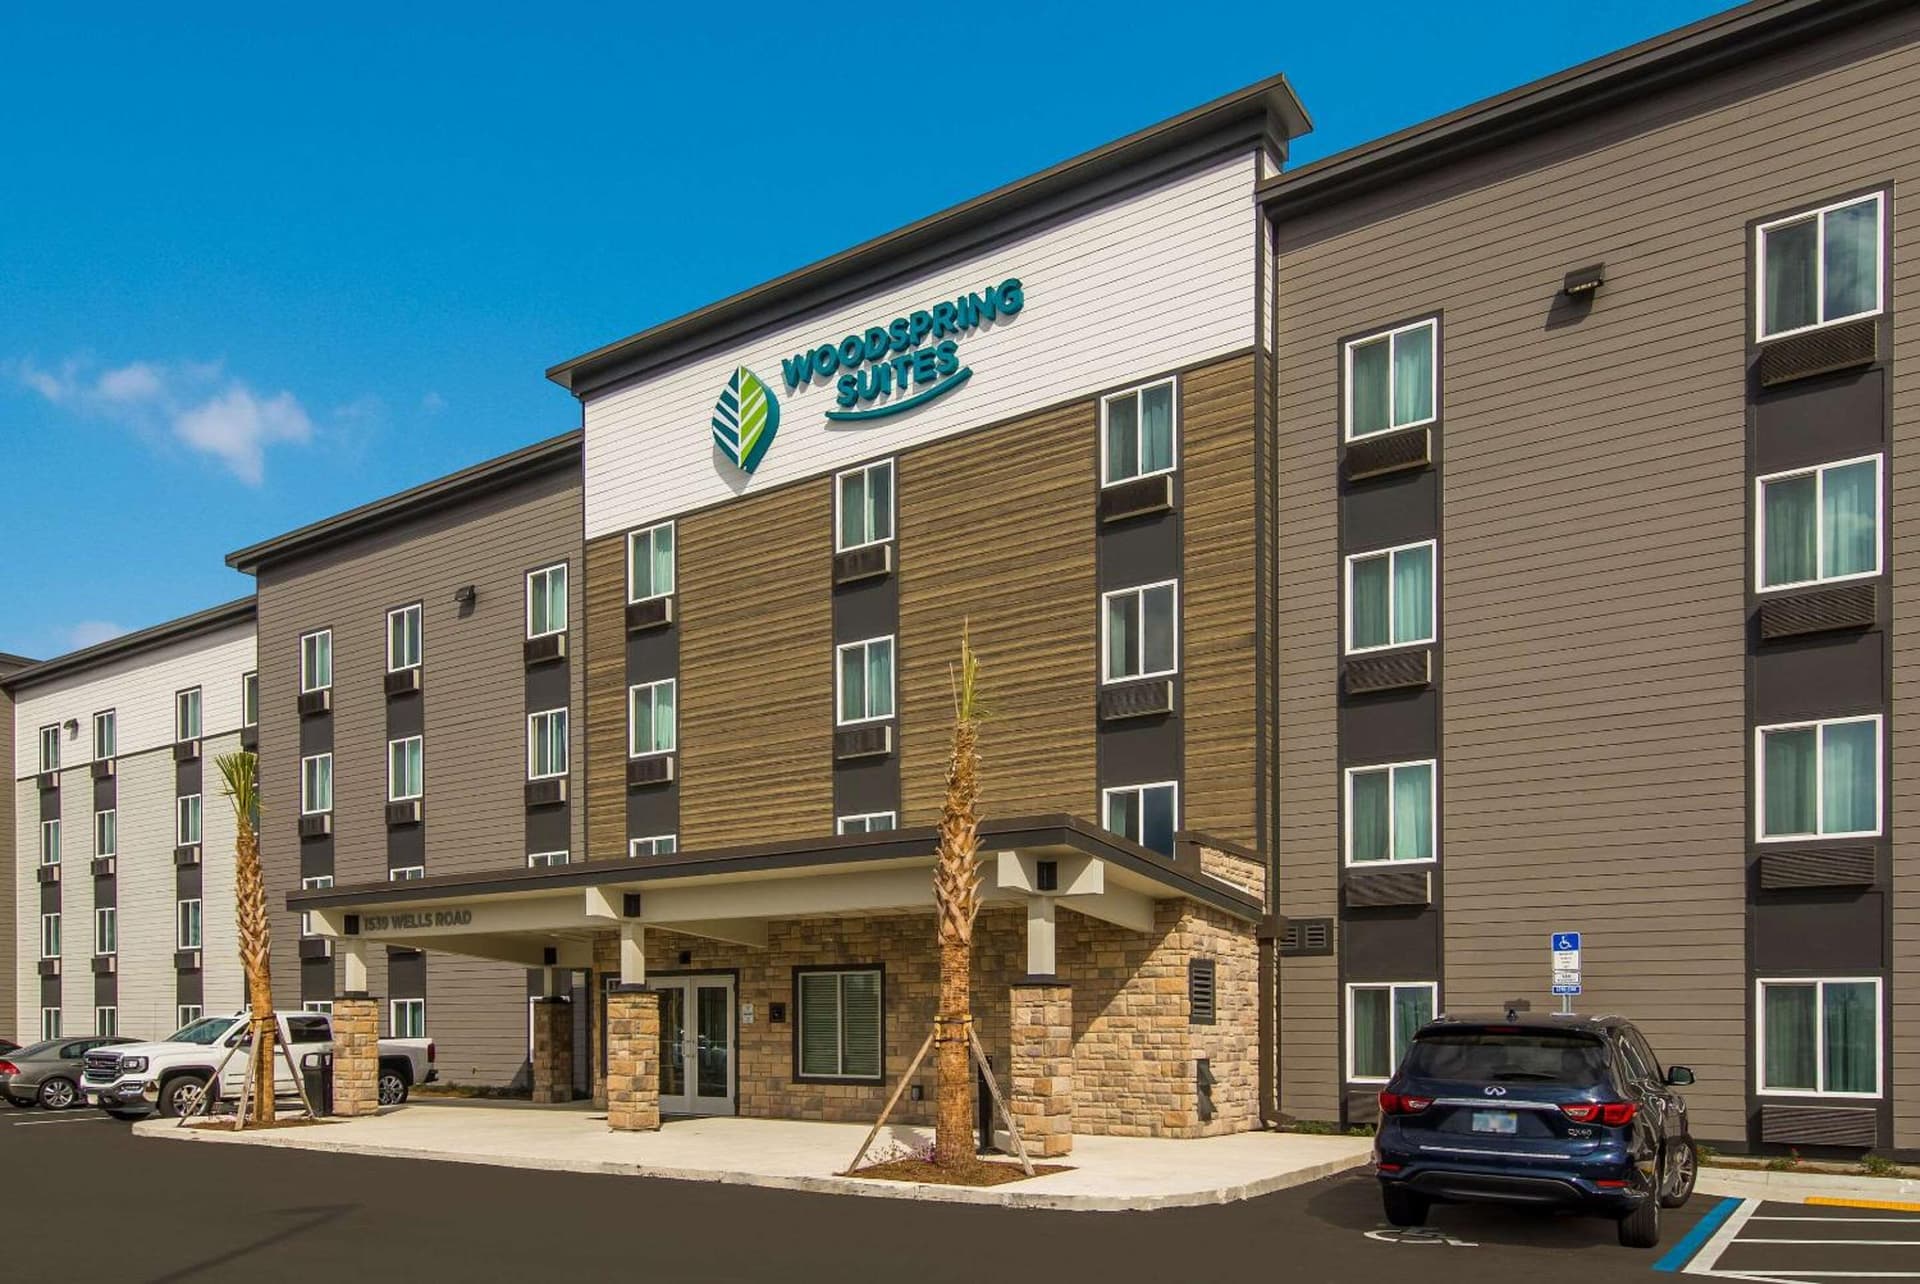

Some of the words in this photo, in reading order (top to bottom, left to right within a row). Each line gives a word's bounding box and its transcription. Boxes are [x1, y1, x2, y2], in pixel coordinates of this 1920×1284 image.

[781, 277, 1025, 389] WOODSPRING
[836, 340, 960, 408] SUITES
[391, 911, 433, 929] WELLS
[435, 909, 472, 927] ROAD
